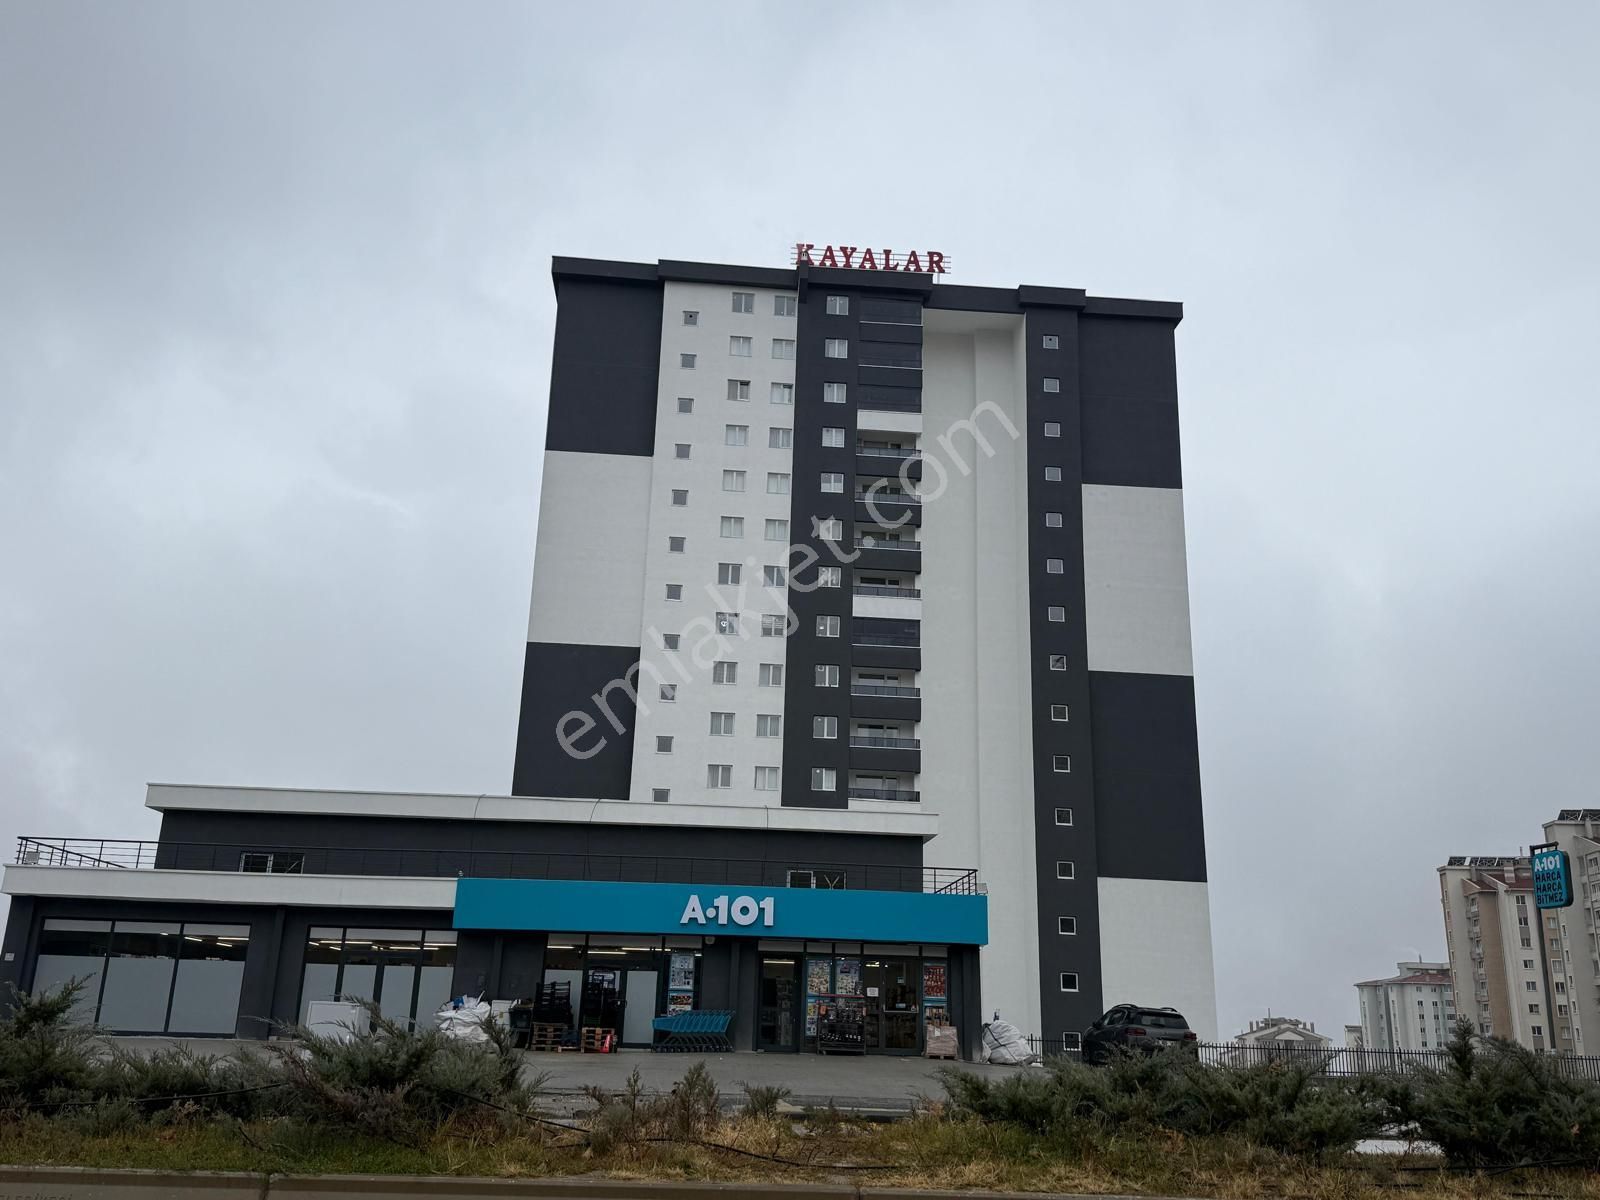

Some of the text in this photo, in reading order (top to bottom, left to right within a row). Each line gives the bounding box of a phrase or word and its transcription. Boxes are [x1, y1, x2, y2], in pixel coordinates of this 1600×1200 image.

[795, 243, 945, 273] KAYALAR
[1535, 871, 1561, 883] HARCA
[1536, 882, 1562, 893] HARCA
